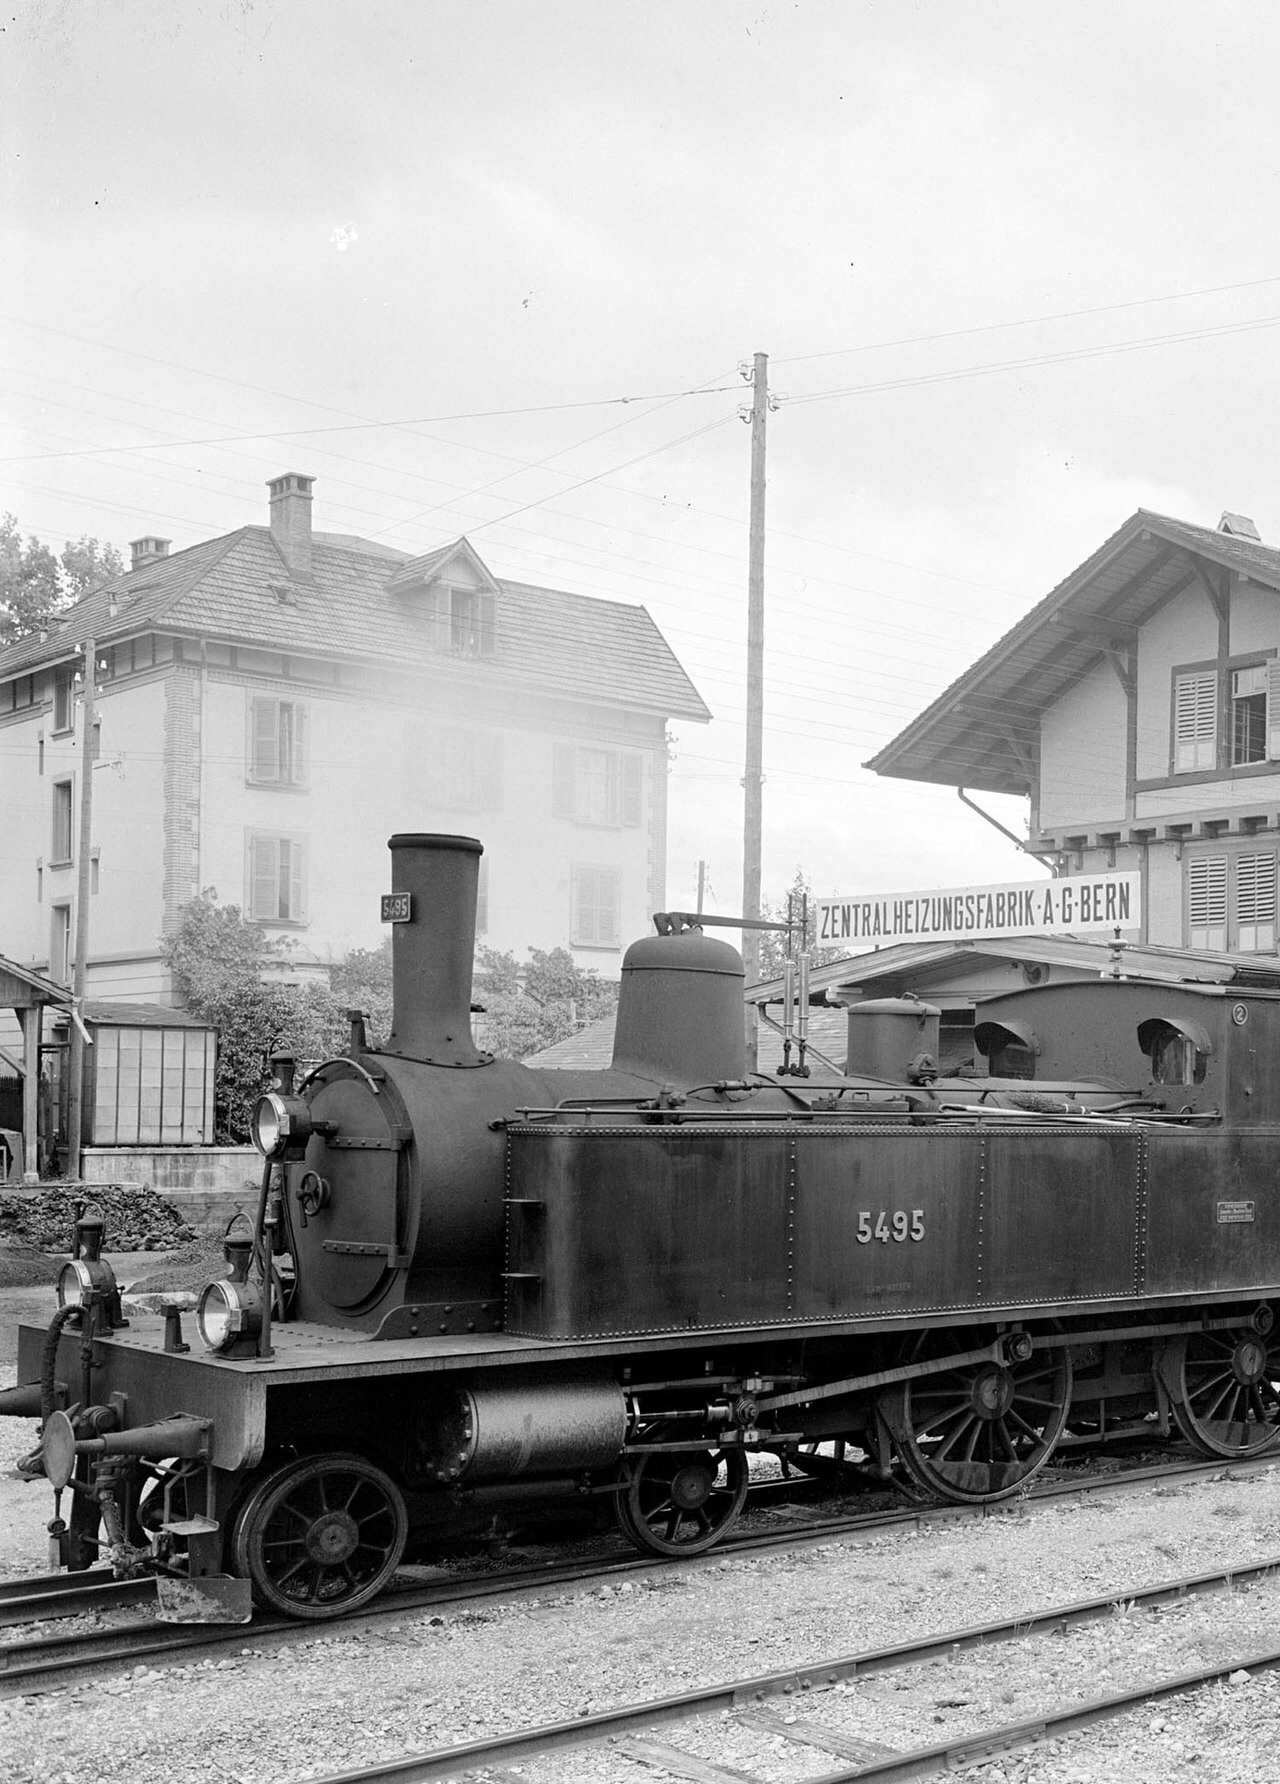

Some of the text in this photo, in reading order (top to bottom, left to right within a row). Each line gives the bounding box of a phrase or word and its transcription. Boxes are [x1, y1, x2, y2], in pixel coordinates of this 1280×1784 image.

[383, 898, 408, 918] 5495
[821, 889, 1035, 940] ZENTRALHEIZUNGSFABRIK
[1080, 882, 1130, 923] BERN
[857, 1209, 925, 1244] 5495
